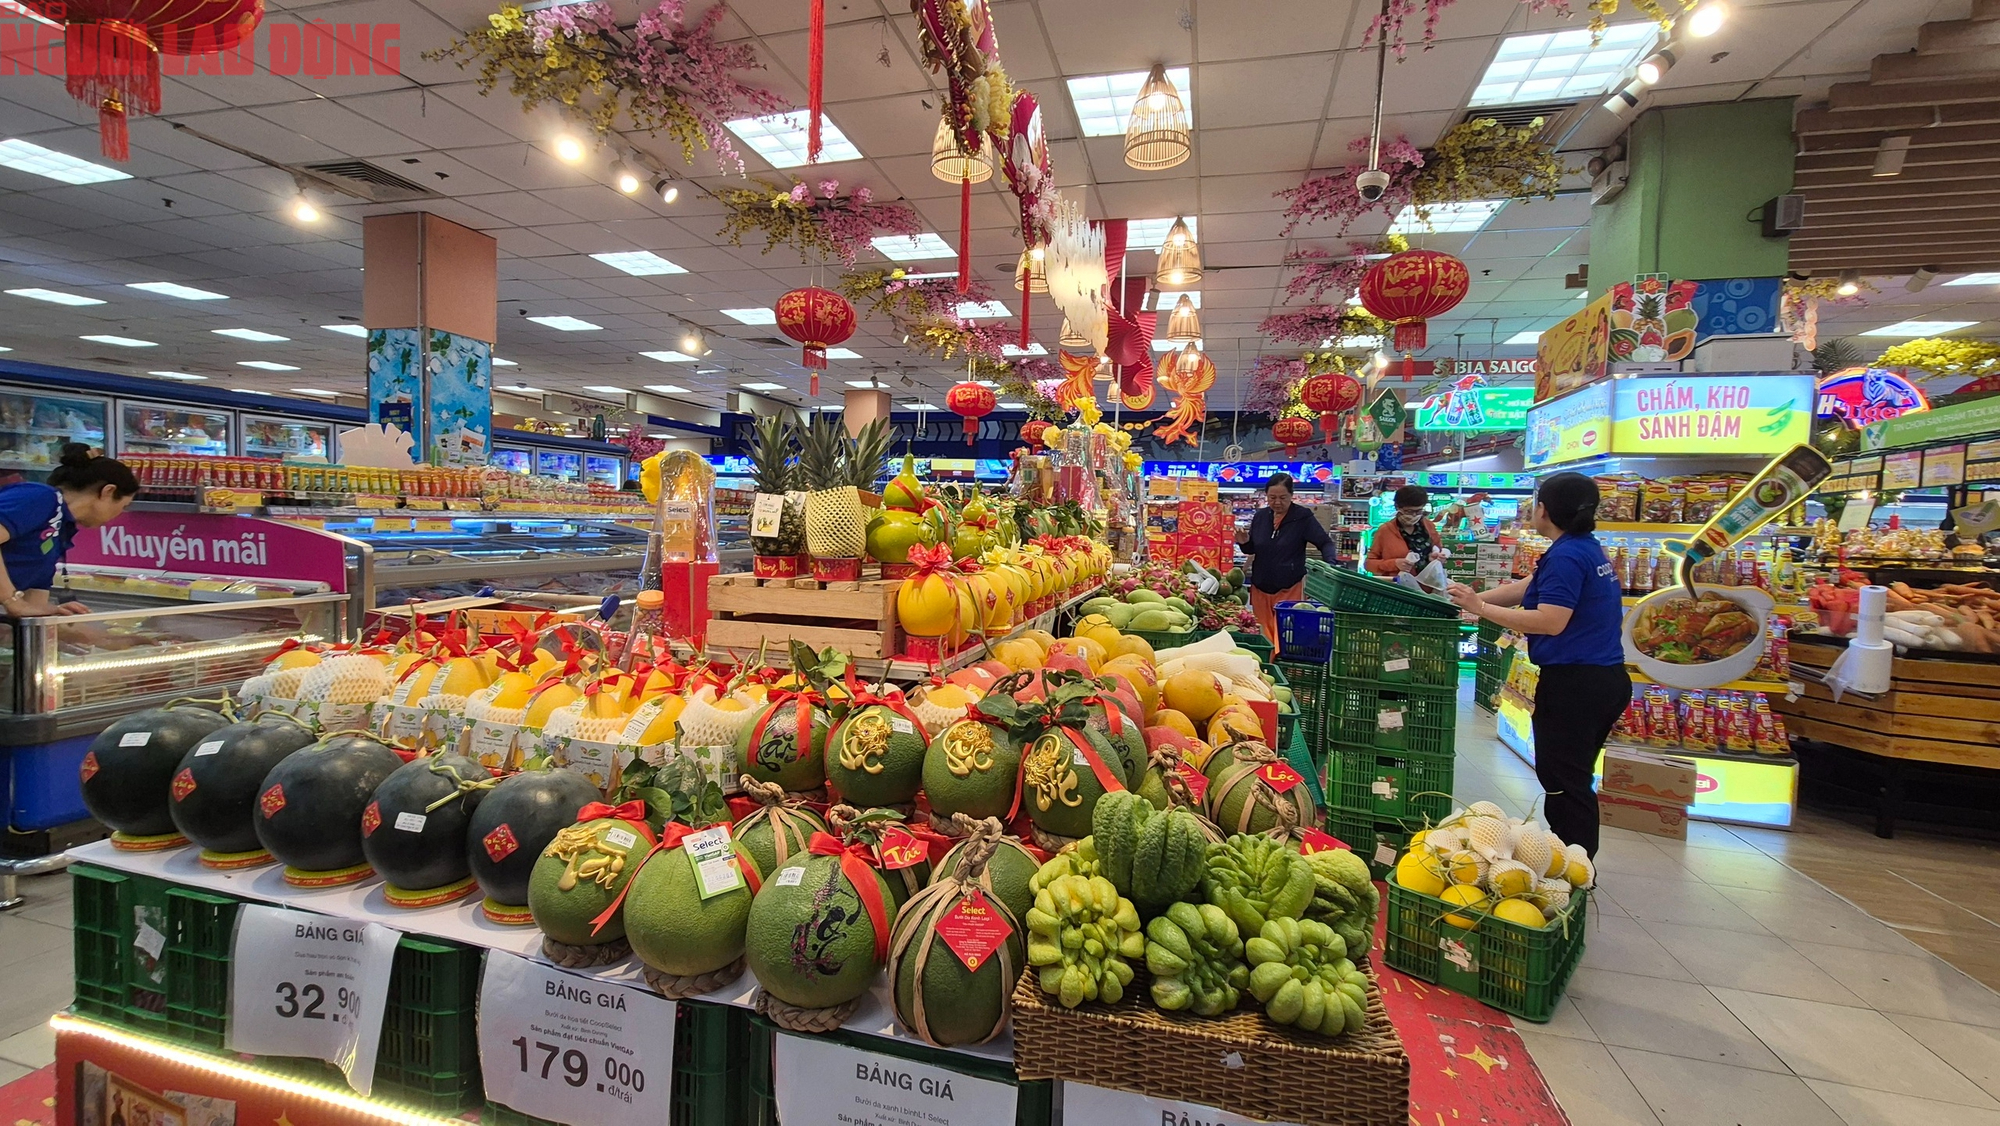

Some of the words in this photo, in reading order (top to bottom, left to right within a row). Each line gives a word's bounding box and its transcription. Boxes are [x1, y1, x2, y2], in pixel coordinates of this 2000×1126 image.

[1454, 360, 1487, 374] BIA
[1489, 359, 1537, 374] SAIGO
[1637, 379, 1700, 412] CHẤM,
[1707, 385, 1750, 410] KHO
[1639, 413, 1691, 440] SÁNH
[1697, 414, 1742, 441] ĐẬM
[667, 506, 690, 514] Select
[100, 524, 206, 568] Khuyến
[212, 532, 267, 566] mãi
[1266, 765, 1296, 782] Lộc
[692, 836, 724, 851] Select
[961, 906, 986, 915] Select
[295, 921, 338, 942] BẢNG
[343, 927, 365, 946] GIÁ
[545, 979, 592, 1006] BẢNG
[597, 991, 628, 1012] GIÁ
[530, 1024, 543, 1033] Sản
[544, 1027, 562, 1039] phẩm
[562, 1032, 573, 1041] đạt
[574, 1034, 588, 1043] tiêu
[588, 1036, 610, 1047] chuẩn
[610, 1041, 635, 1056] VietGAP
[855, 1061, 913, 1091] BẢNG
[918, 1077, 955, 1102] GIÁ
[608, 1085, 633, 1104] đ/trái
[1161, 1109, 1227, 1126] BẢ
